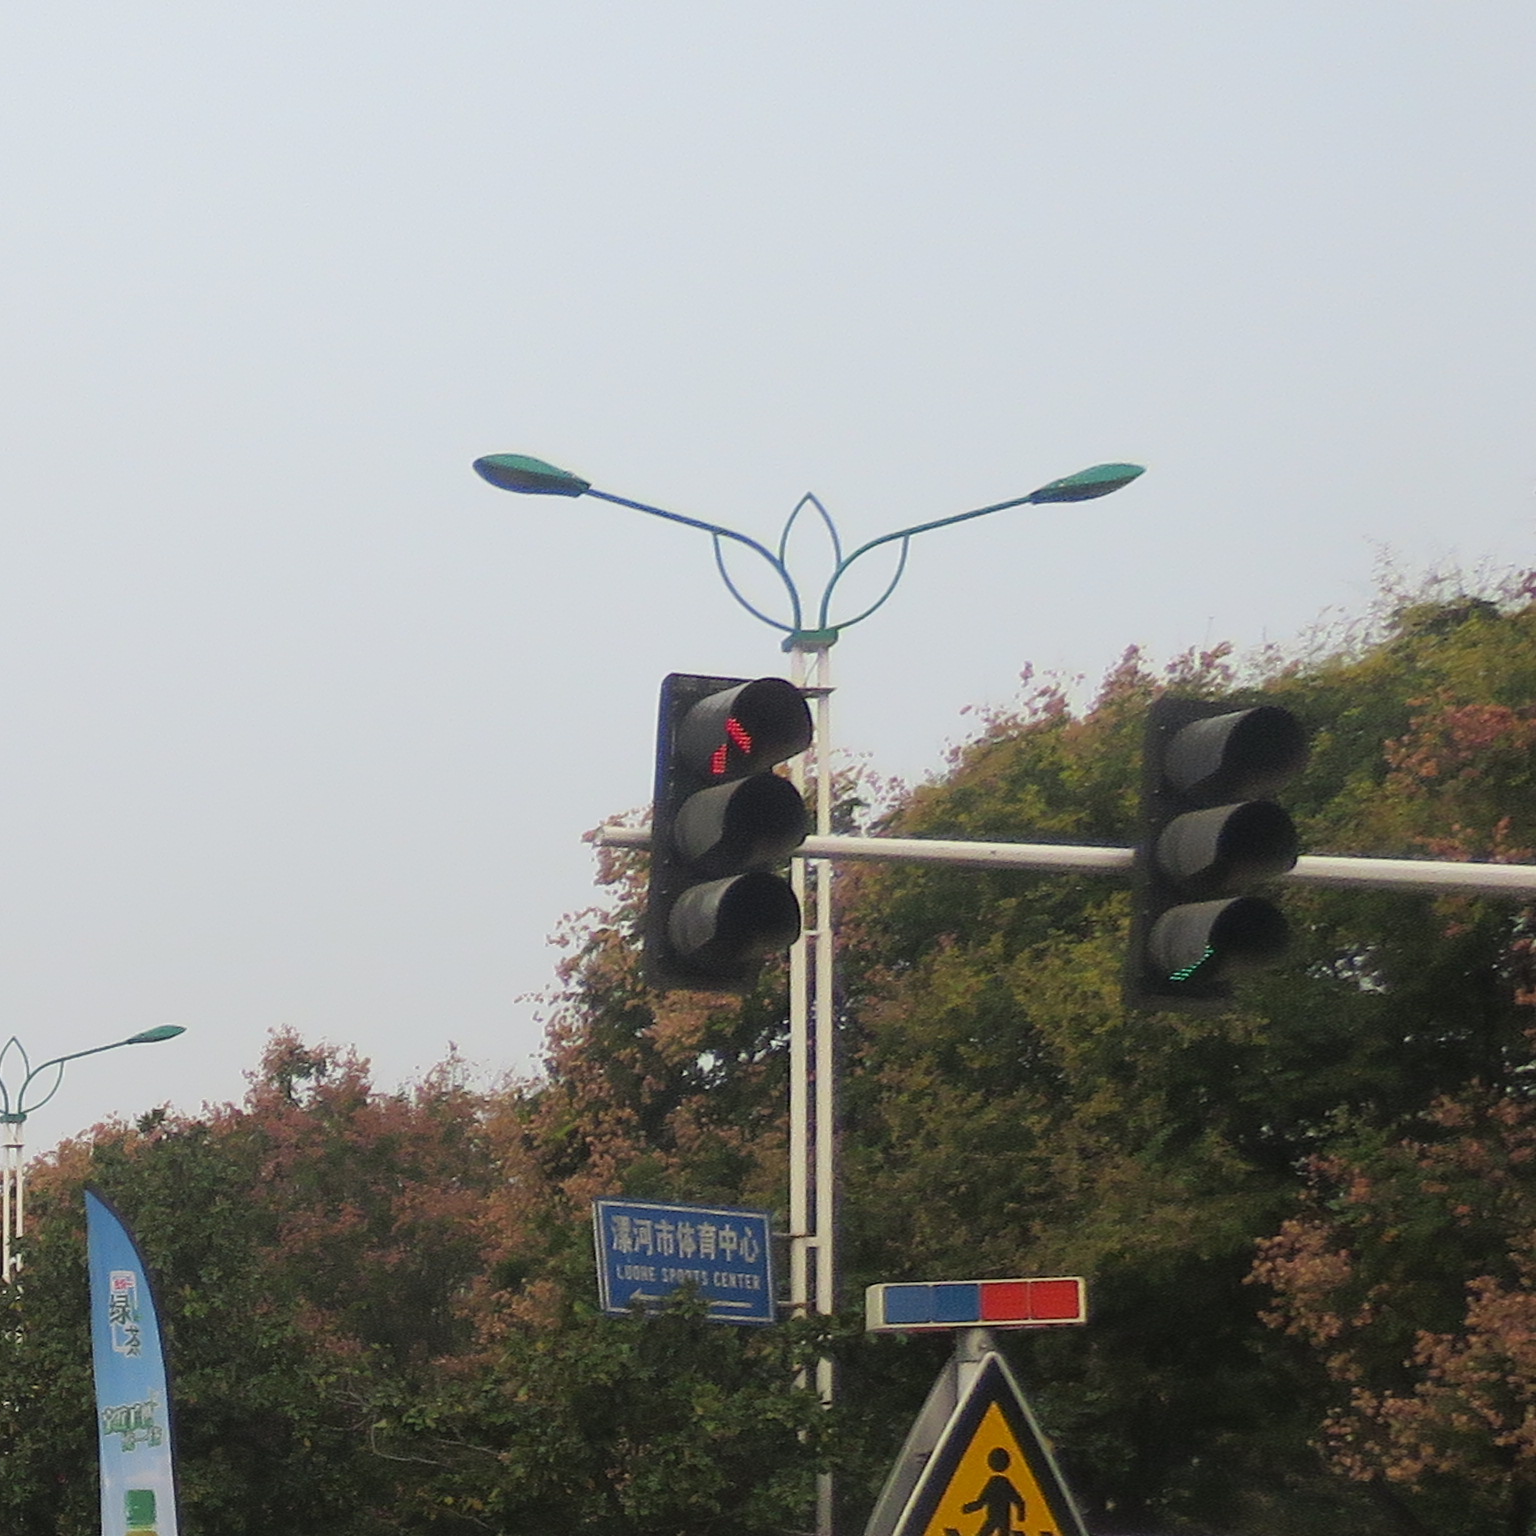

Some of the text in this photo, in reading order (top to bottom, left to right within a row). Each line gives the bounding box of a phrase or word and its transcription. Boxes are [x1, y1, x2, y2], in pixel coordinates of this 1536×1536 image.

[611, 1214, 759, 1264] 漯河市体育中心
[616, 1264, 657, 1282] LUOHE
[713, 1271, 762, 1290] CENTER
